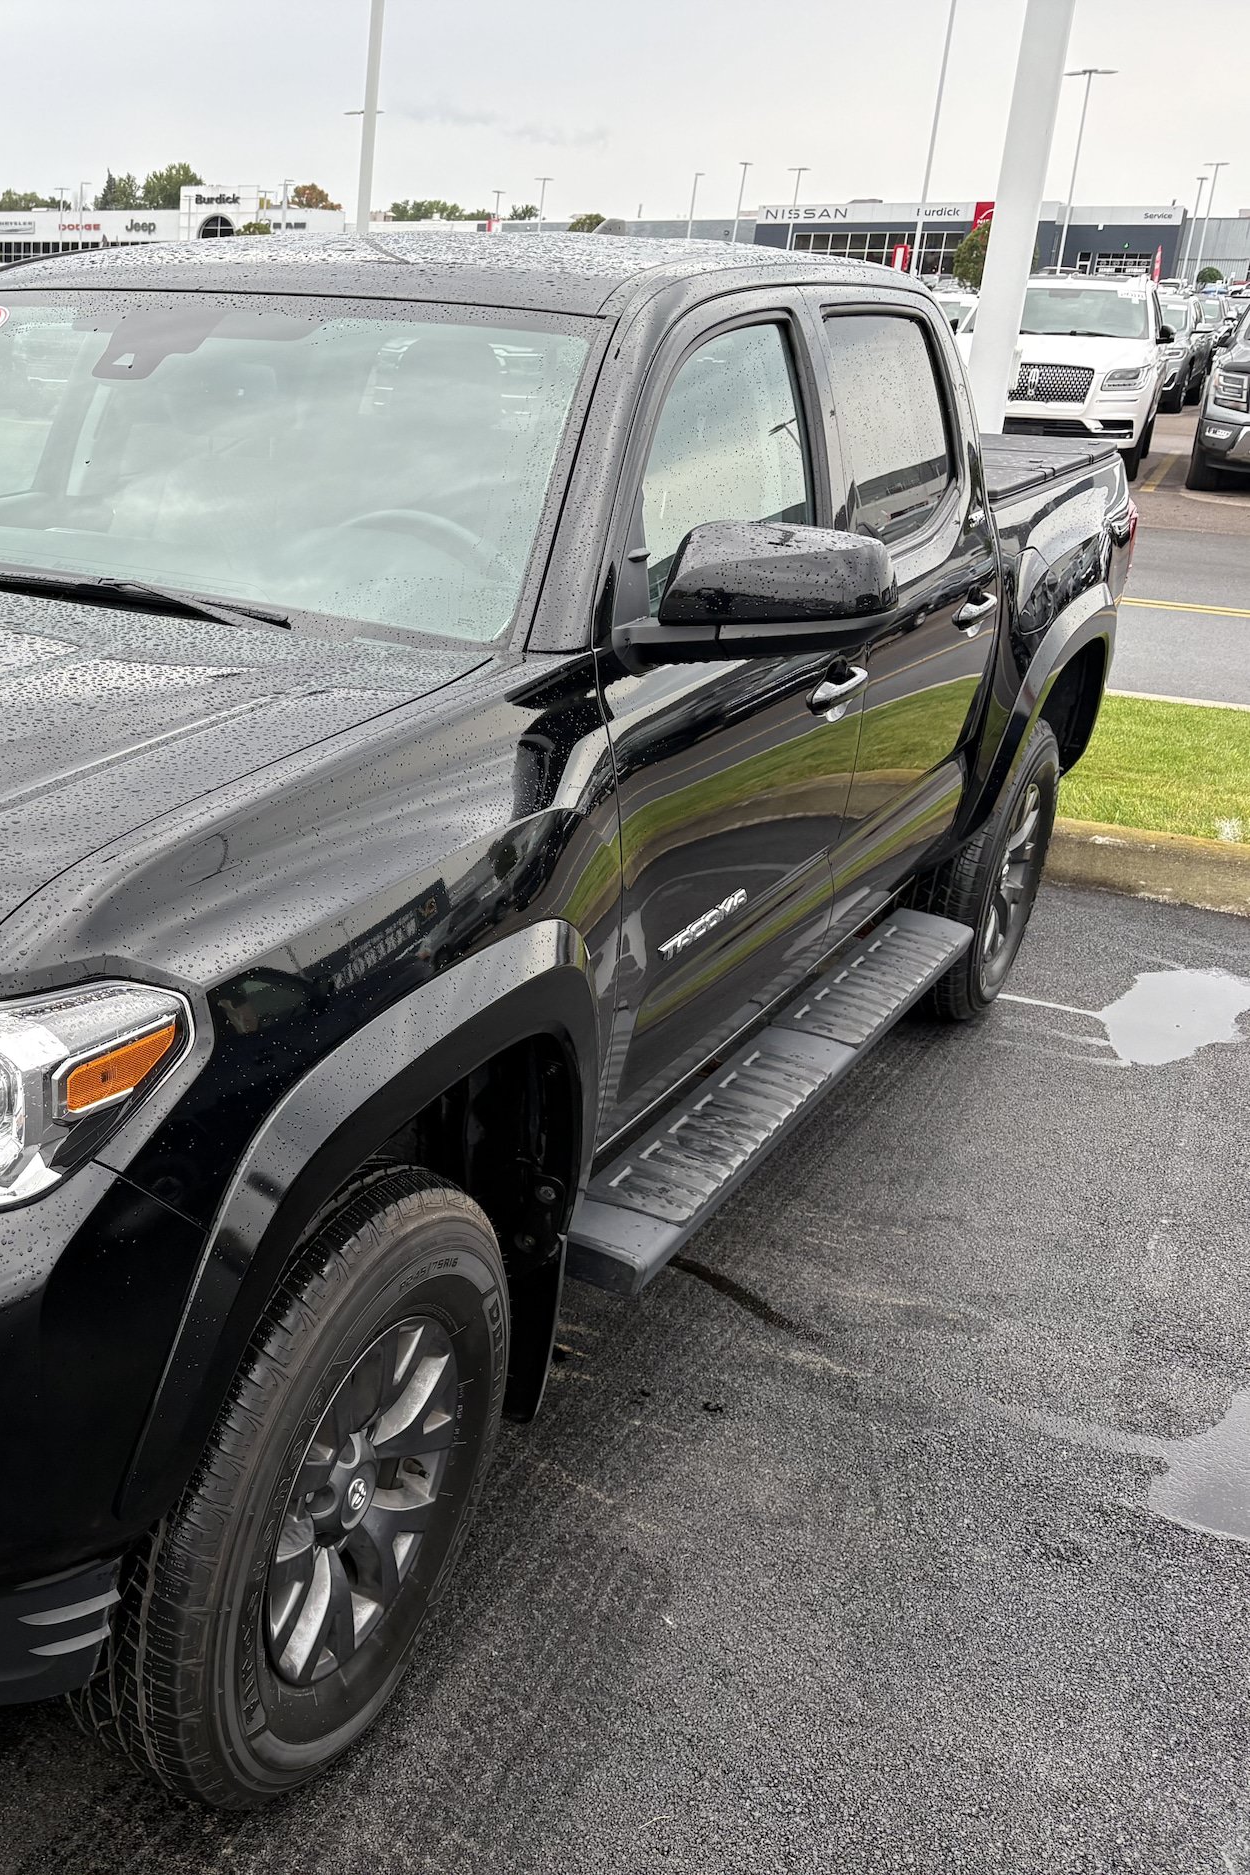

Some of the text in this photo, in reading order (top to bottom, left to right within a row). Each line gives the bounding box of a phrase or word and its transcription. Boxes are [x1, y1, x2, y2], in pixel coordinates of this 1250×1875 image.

[195, 193, 241, 205] Burdick
[765, 207, 849, 220] NISSAN
[1143, 212, 1174, 220] Service
[58, 223, 101, 231] DODGE
[125, 218, 156, 235] Jeep
[657, 887, 749, 961] TACOMA
